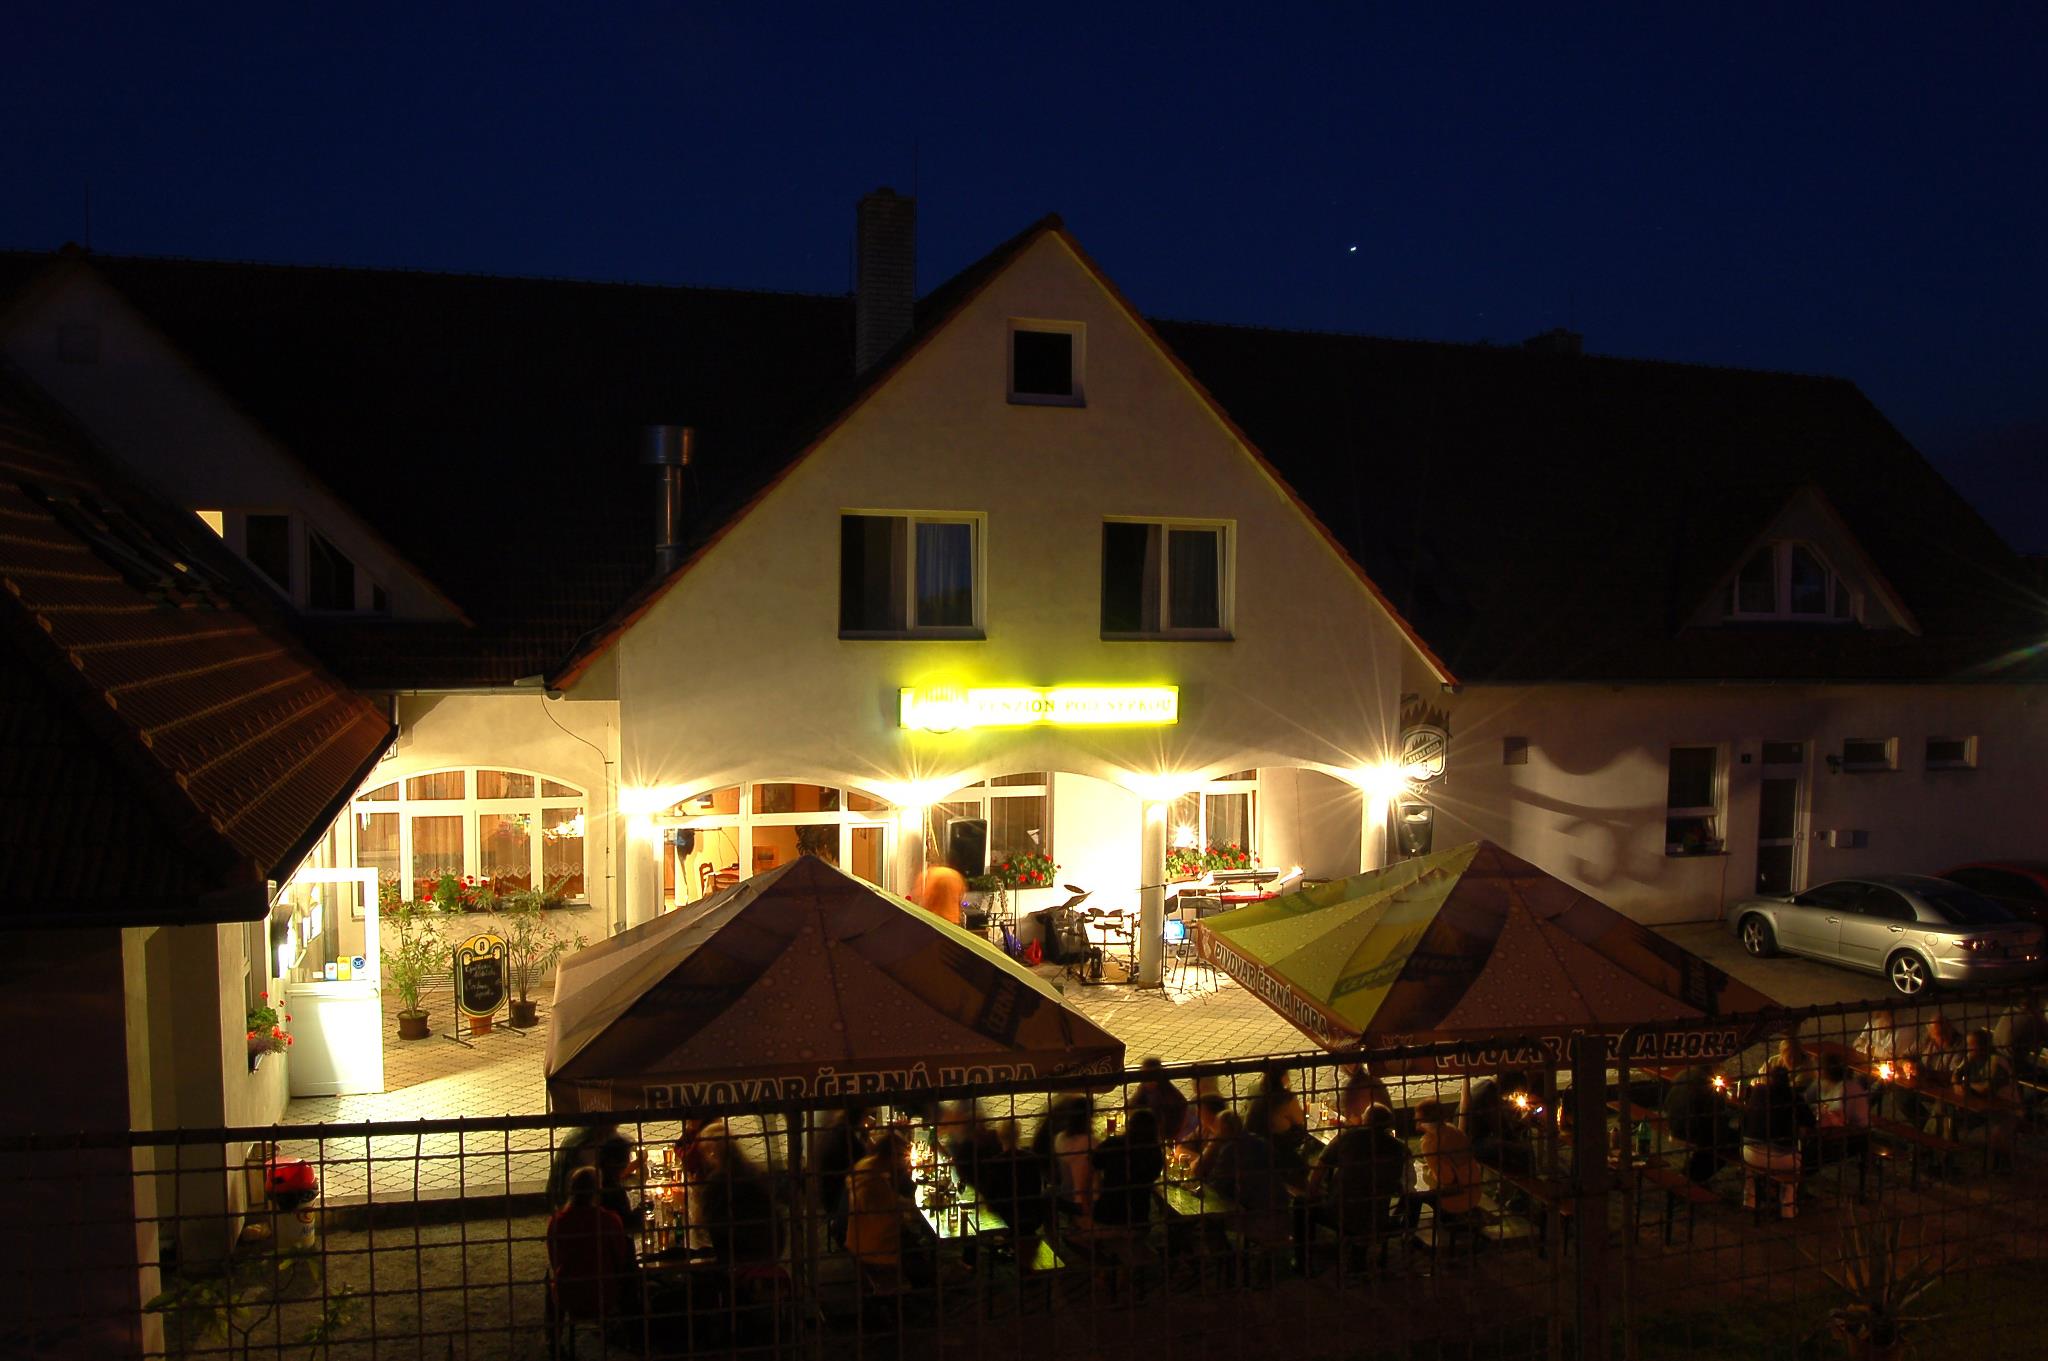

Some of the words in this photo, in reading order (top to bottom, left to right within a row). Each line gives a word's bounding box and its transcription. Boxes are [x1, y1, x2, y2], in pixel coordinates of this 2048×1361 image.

[1213, 940, 1256, 991] PIVOVAR
[1256, 965, 1293, 1018] ČERNÁ
[1293, 994, 1331, 1044] HORA
[1662, 1031, 1738, 1058] HORA
[643, 1076, 807, 1111] PIVOVAR
[814, 1061, 933, 1098] ČERNÁ
[938, 1063, 1038, 1088] HORA
